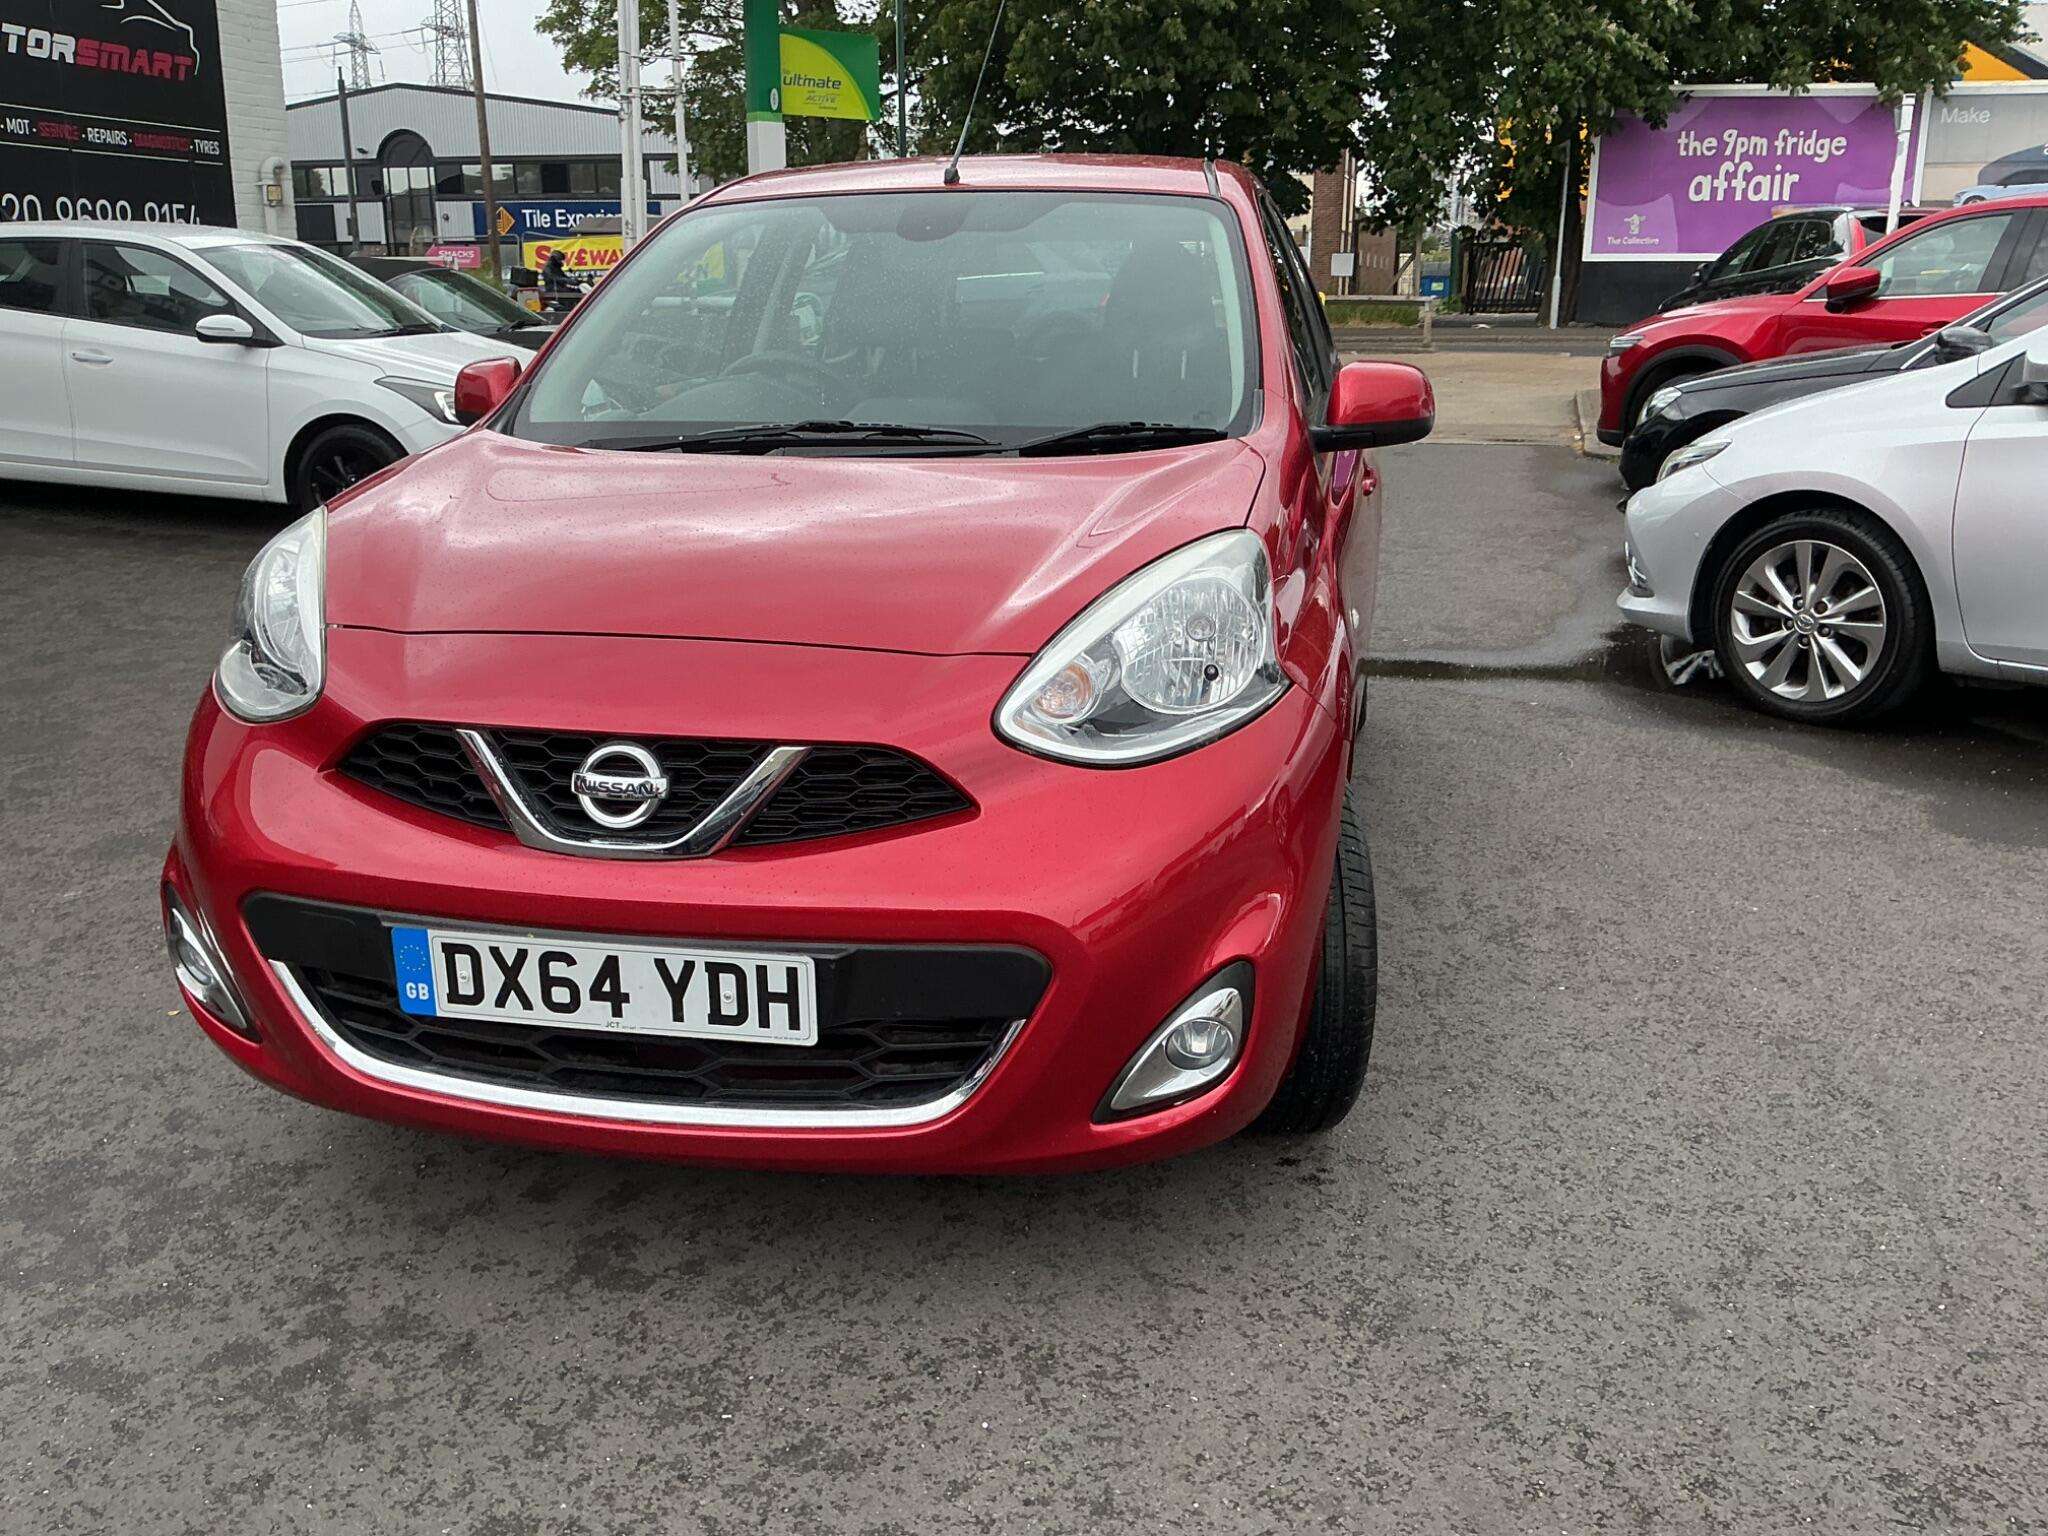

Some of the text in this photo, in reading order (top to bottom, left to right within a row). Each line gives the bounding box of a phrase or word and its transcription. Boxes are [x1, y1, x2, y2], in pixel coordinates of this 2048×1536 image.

[2, 23, 193, 81] TORSMART
[783, 73, 842, 89] ultimate
[1941, 107, 1991, 123] Make
[6, 118, 30, 135] MOT
[87, 127, 128, 146] REPAIRS
[194, 139, 220, 155] TYRES
[1677, 128, 1847, 163] the 9pm fridge
[1688, 161, 1800, 201] affair
[522, 209, 551, 228] Tile
[577, 776, 655, 796] NISSAN
[406, 982, 430, 1000] GB
[441, 941, 801, 1031] DX64 YDH
